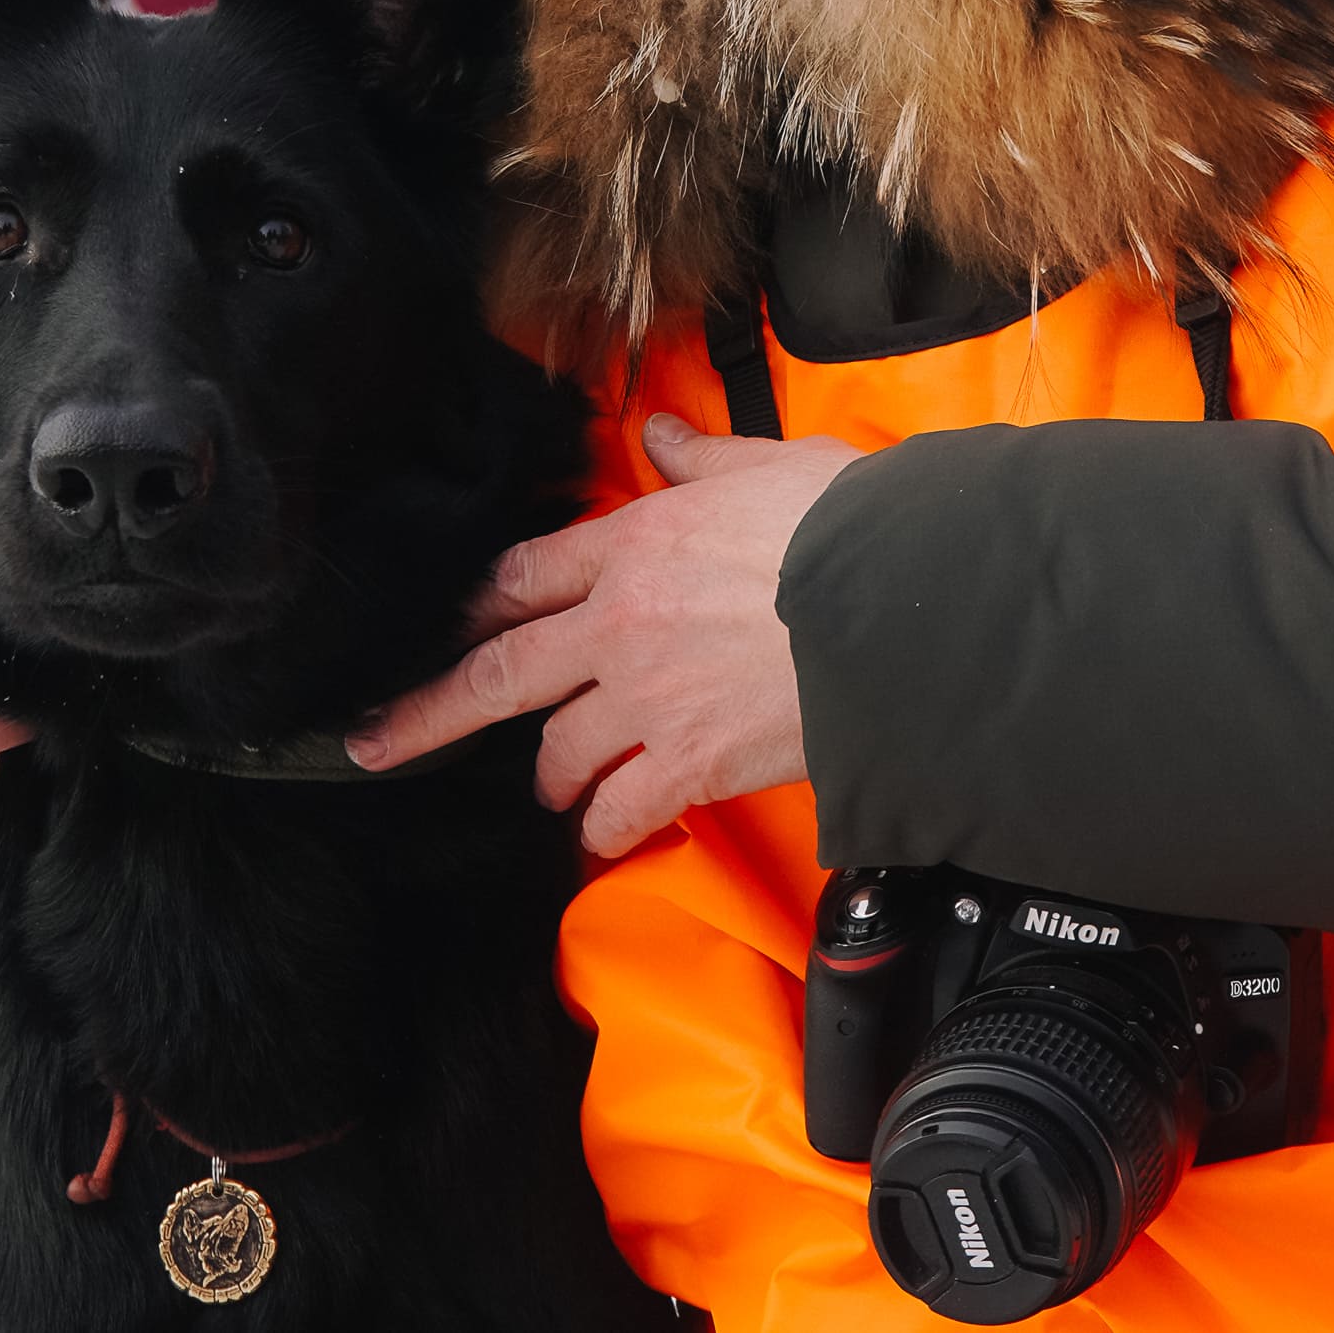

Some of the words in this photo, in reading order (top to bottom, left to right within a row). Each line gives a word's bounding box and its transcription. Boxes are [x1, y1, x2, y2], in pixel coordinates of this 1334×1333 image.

[1024, 907, 1120, 945] Nikon
[1231, 978, 1280, 997] D3200
[947, 1189, 994, 1268] Nikon
